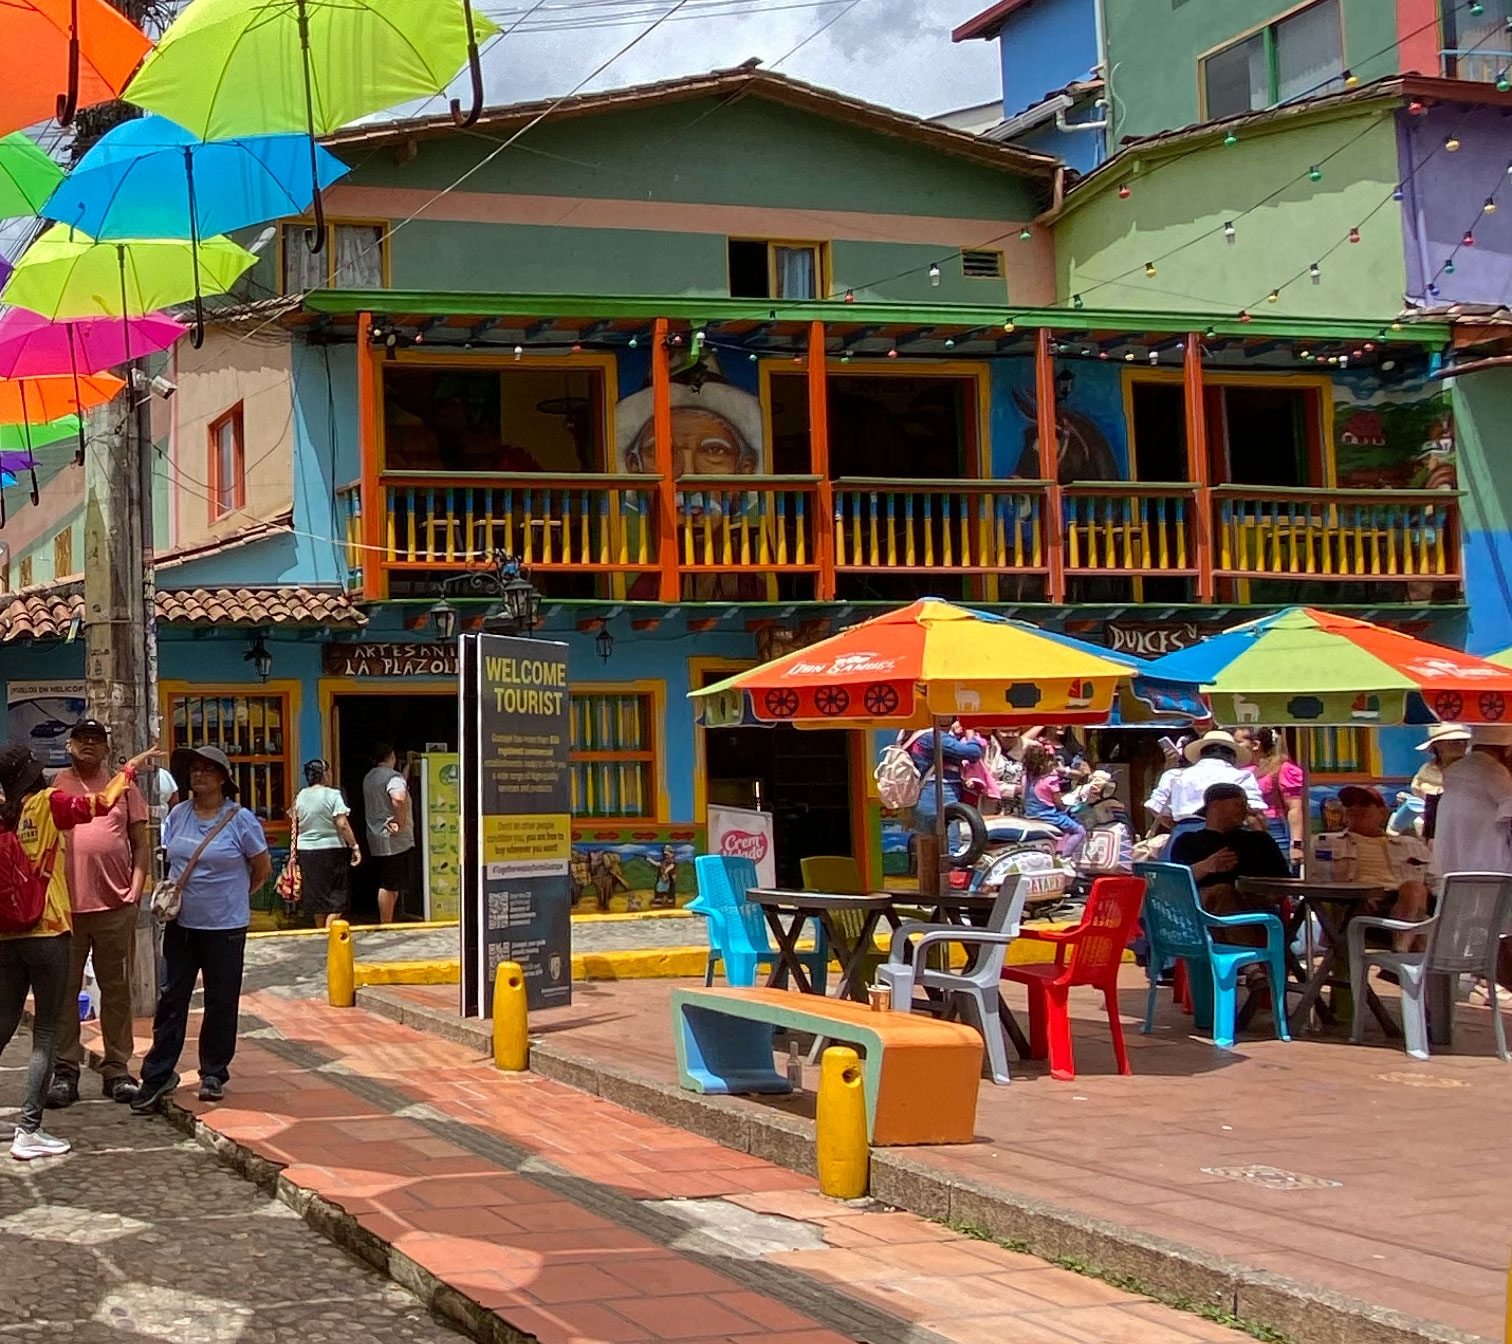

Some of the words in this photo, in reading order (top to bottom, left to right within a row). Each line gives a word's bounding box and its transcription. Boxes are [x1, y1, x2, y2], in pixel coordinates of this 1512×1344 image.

[1109, 624, 1185, 654] DULCES
[345, 659, 370, 675] LA
[485, 656, 566, 687] WELCOME
[494, 687, 563, 716] TOURIST
[724, 834, 760, 851] Crem
